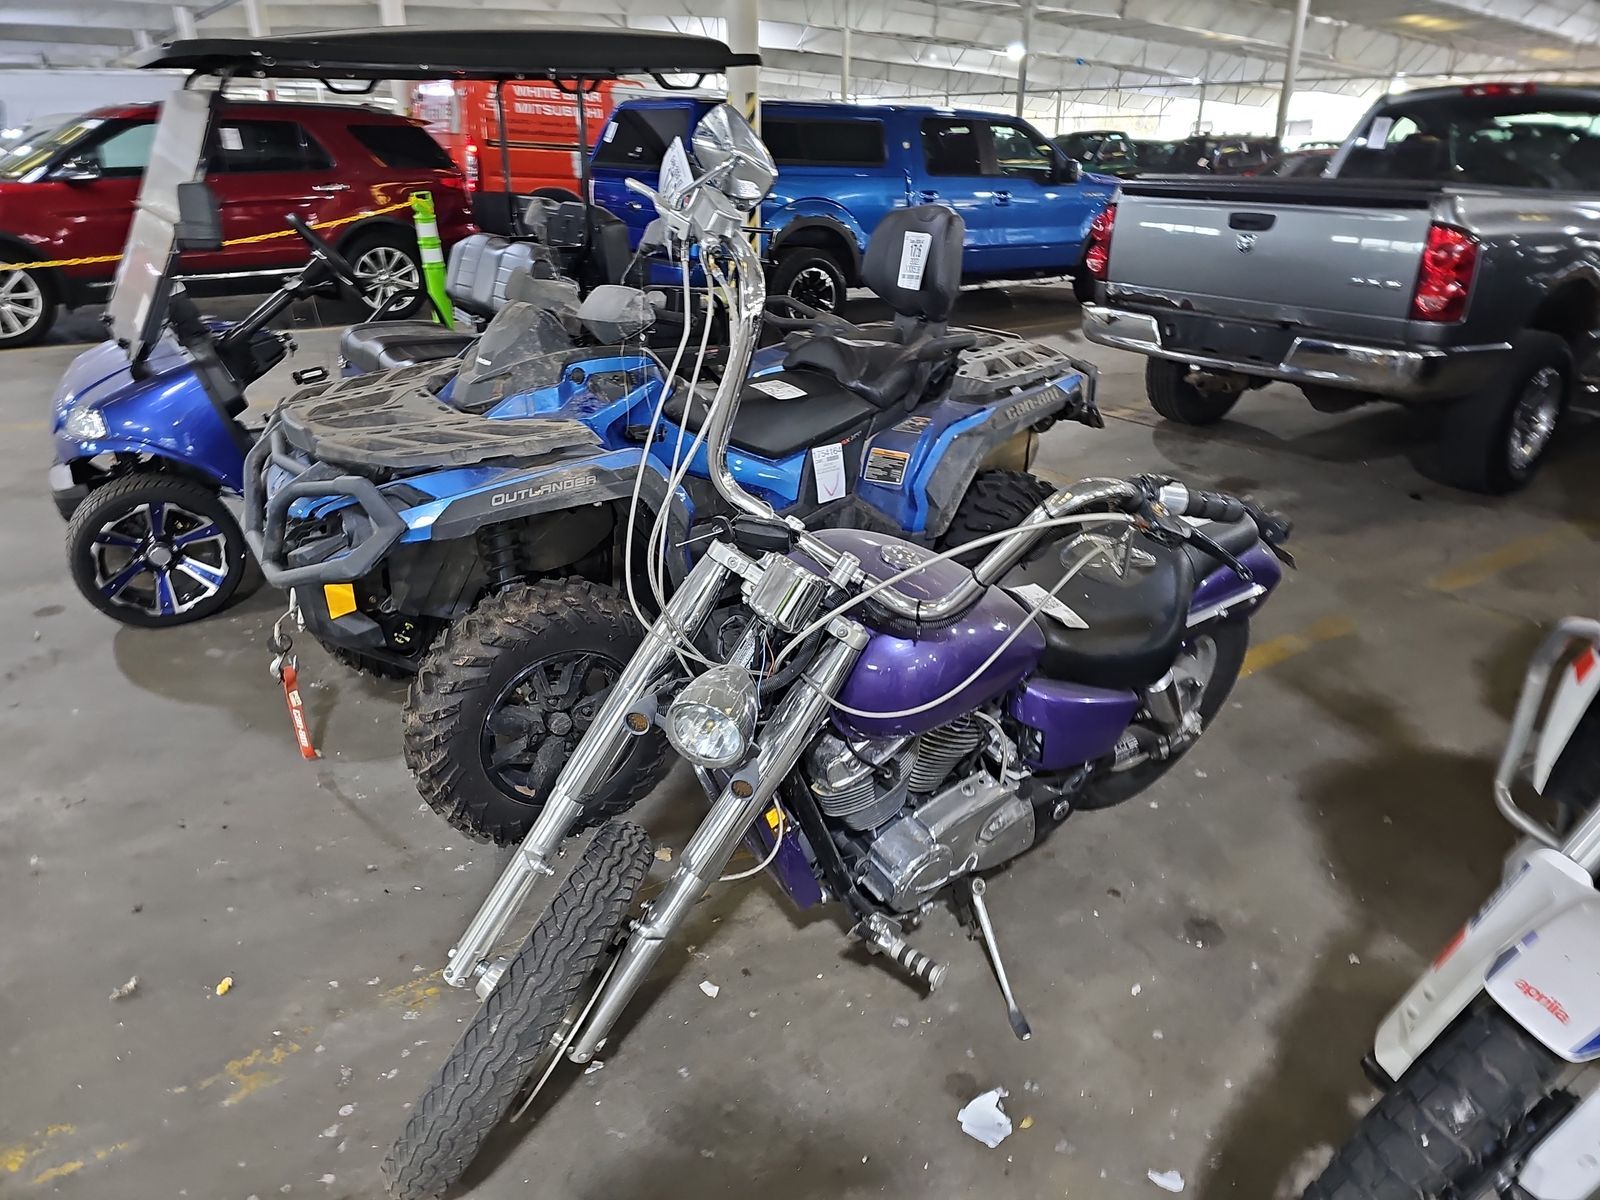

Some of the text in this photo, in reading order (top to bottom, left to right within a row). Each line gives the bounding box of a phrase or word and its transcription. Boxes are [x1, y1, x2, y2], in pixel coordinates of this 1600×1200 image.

[512, 85, 560, 99] WHITE
[491, 475, 597, 507] OUTLANDER
[1514, 978, 1570, 1025] aprilia
